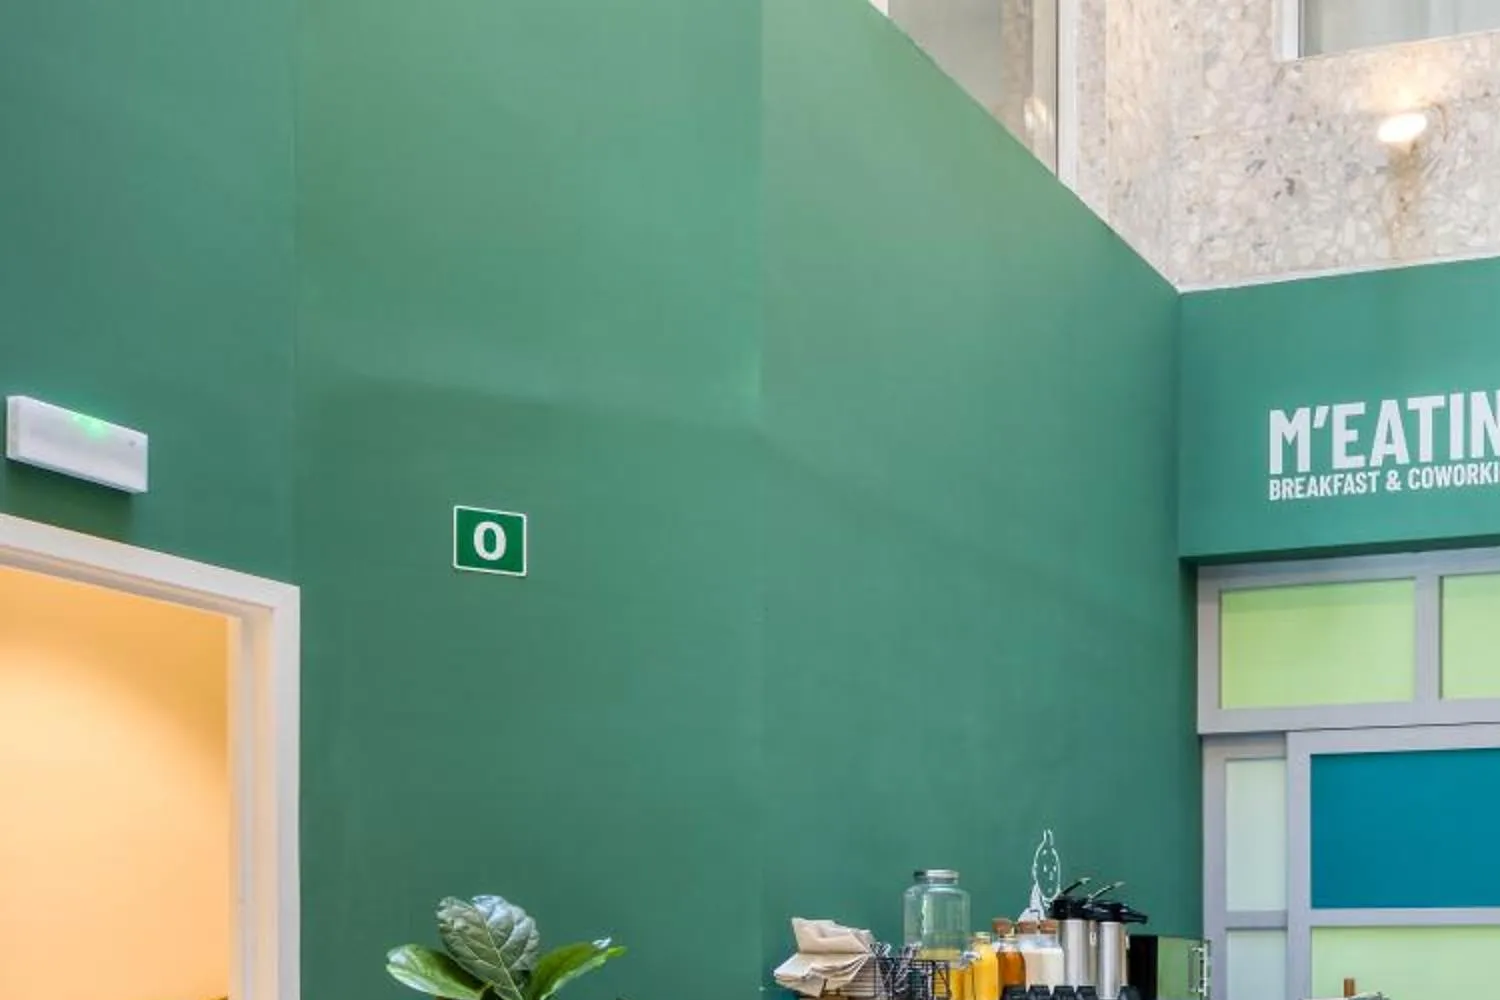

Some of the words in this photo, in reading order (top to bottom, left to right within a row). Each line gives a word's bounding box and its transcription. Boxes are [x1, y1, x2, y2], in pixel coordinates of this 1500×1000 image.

[1269, 470, 1380, 501] BREAKFAST
[1385, 469, 1402, 491] &
[473, 521, 506, 561] 0
